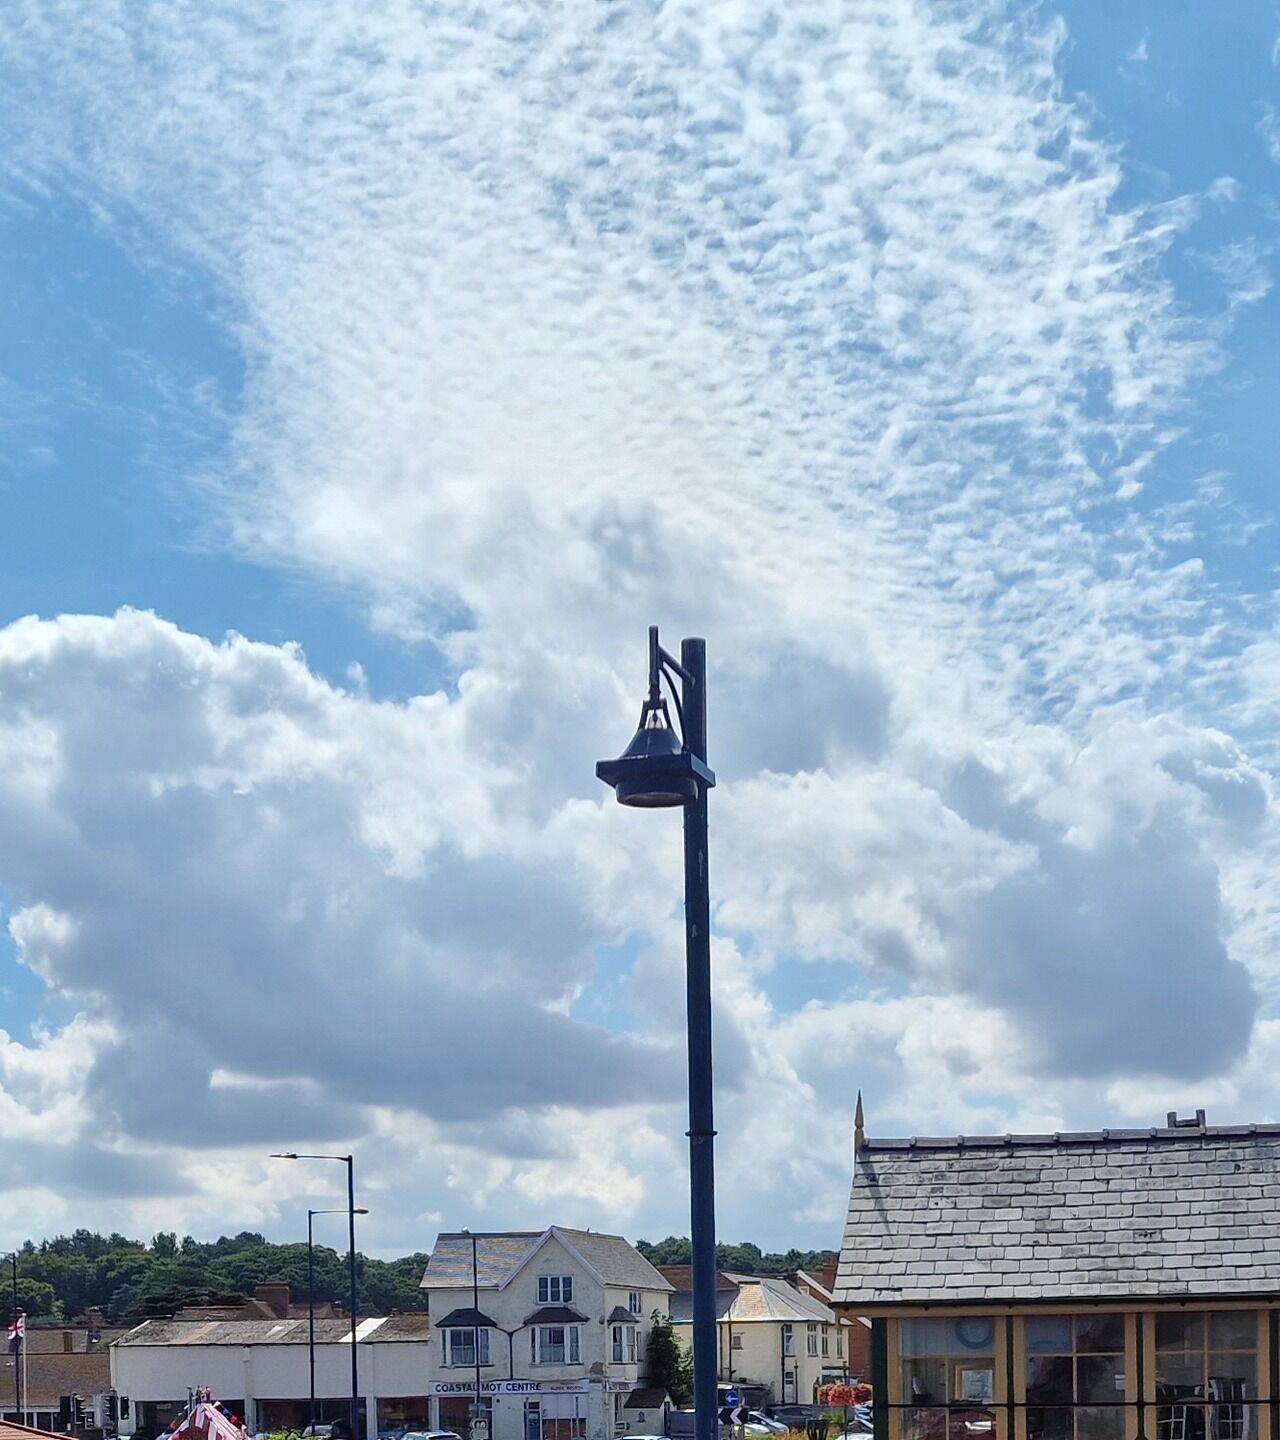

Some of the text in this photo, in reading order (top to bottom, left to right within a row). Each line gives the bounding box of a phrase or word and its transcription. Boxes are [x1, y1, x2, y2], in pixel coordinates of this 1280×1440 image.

[435, 1383, 477, 1392] COASTAL
[481, 1383, 502, 1392] MOT
[506, 1382, 542, 1391] CENTRE
